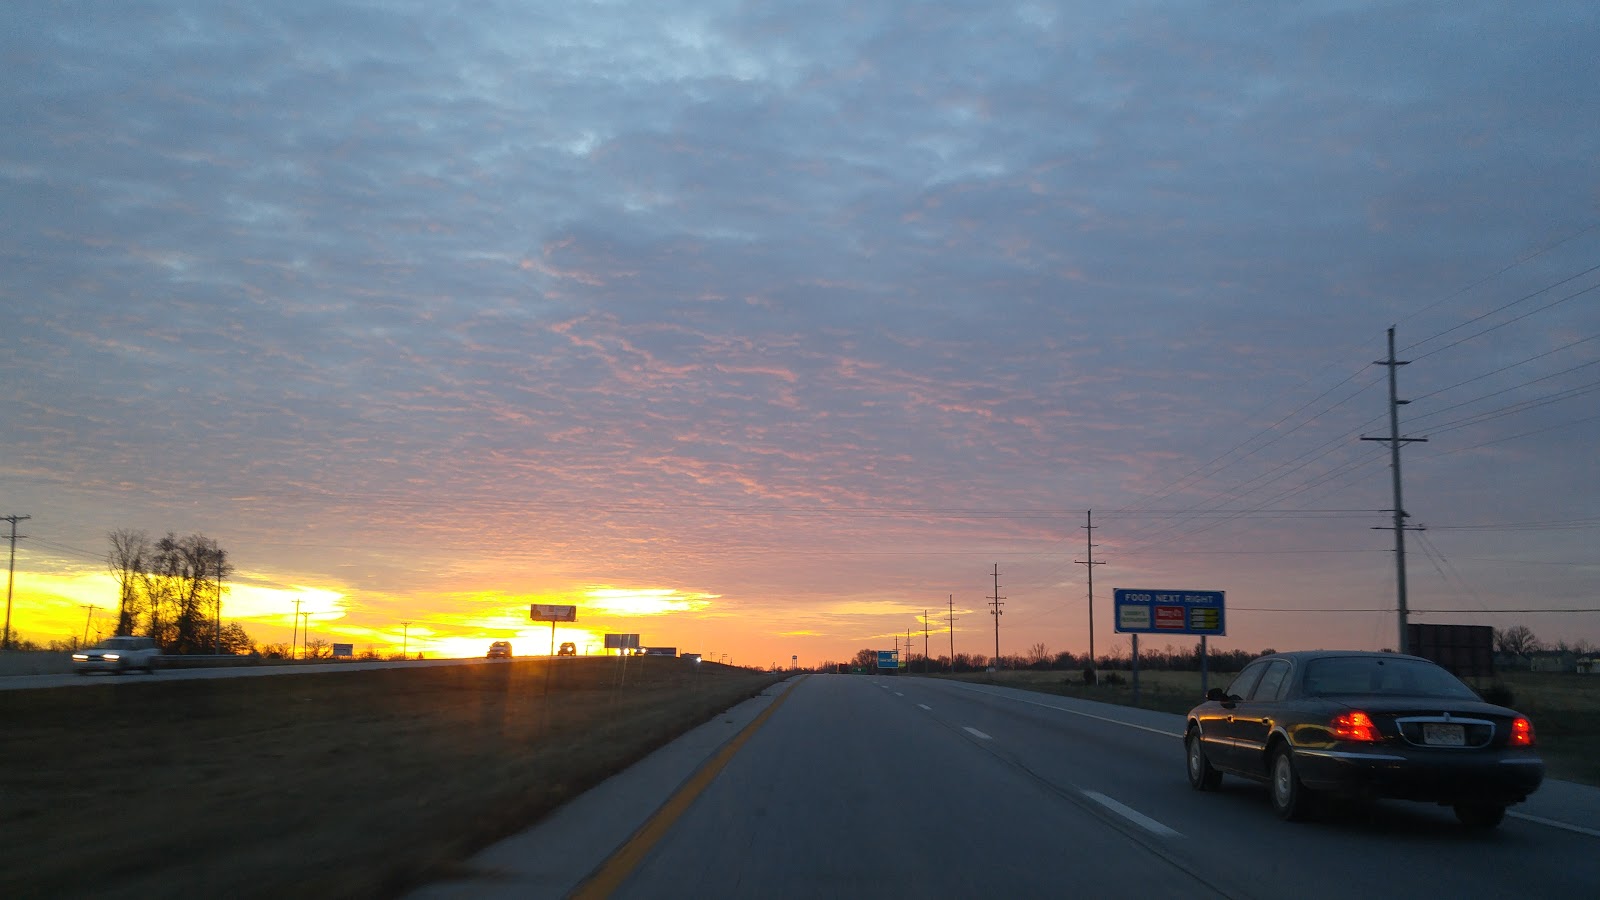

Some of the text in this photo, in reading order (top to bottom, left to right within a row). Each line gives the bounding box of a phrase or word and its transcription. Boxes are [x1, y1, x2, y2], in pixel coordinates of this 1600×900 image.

[1124, 593, 1214, 603] FOOD NEXT RIGHT
